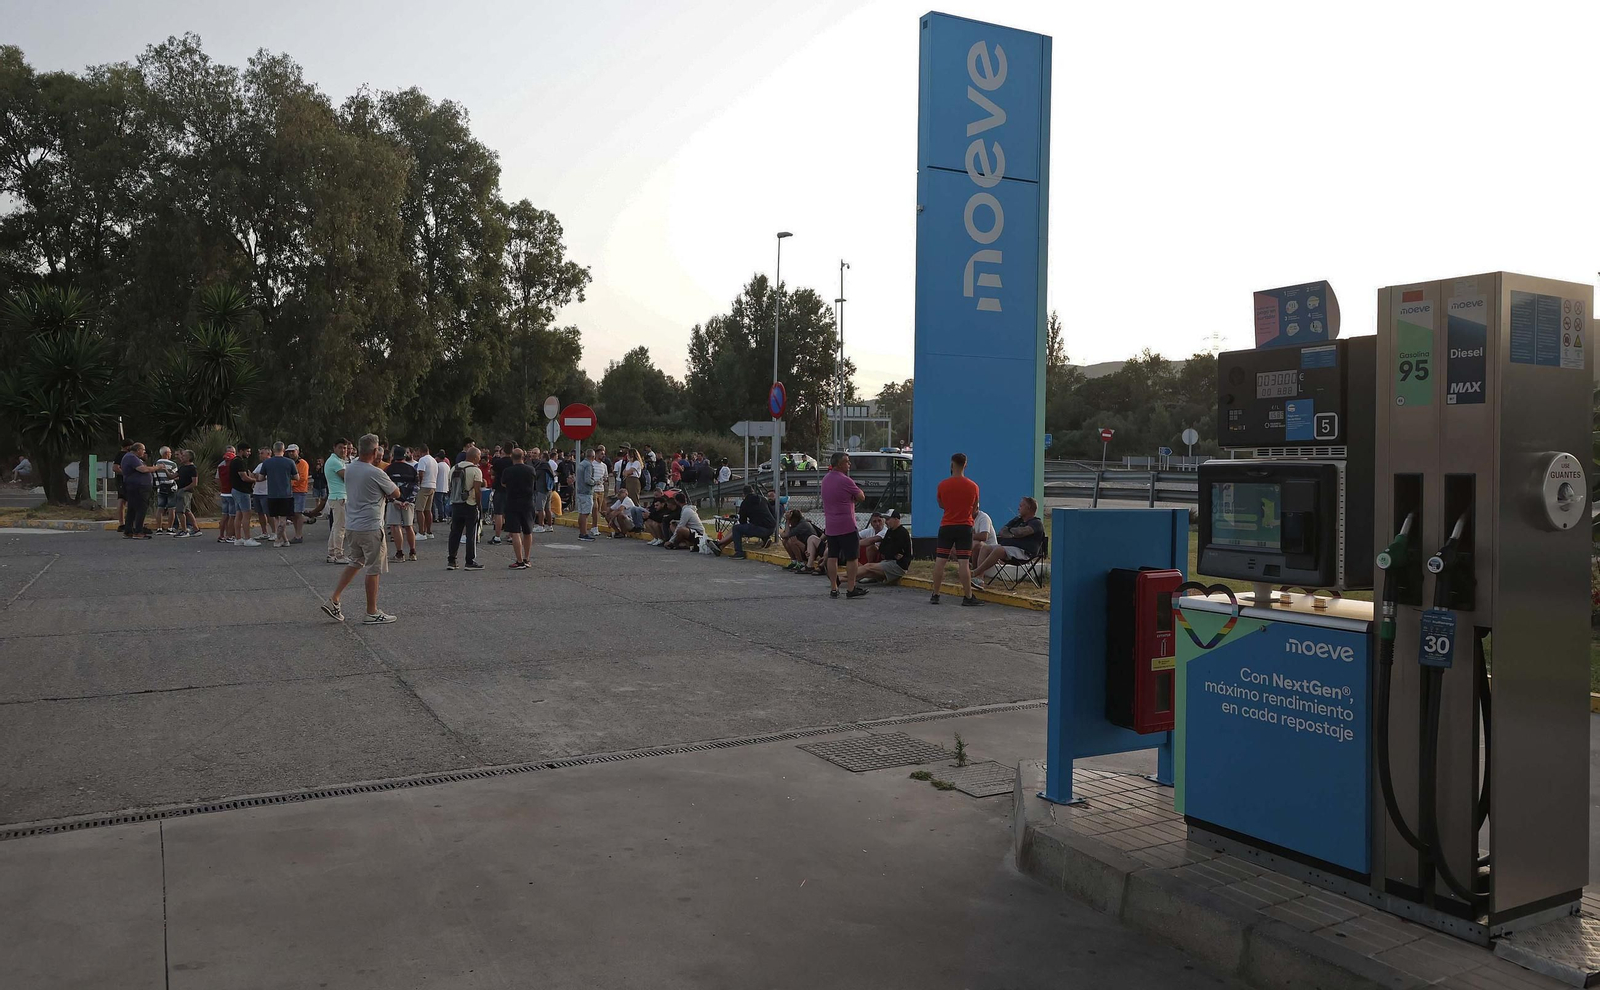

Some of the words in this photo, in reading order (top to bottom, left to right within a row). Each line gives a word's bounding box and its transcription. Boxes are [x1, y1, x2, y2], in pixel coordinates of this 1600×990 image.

[963, 40, 1008, 312] moeve
[1400, 305, 1430, 315] moeve
[1451, 300, 1484, 310] moeve
[1399, 350, 1429, 359] Gasolina
[1450, 347, 1483, 359] Diesel
[1399, 360, 1429, 382] 95
[1450, 381, 1482, 394] MAX
[1321, 419, 1330, 433] 5
[1550, 471, 1581, 479] GUANTES
[1286, 638, 1354, 662] moeve
[1424, 635, 1450, 654] 30
[1240, 667, 1268, 685] Con
[1204, 681, 1259, 701] máximo
[1263, 692, 1354, 721] rendimiento
[1221, 702, 1238, 715] en
[1241, 707, 1277, 724] cada
[1281, 714, 1354, 742] repostaje
